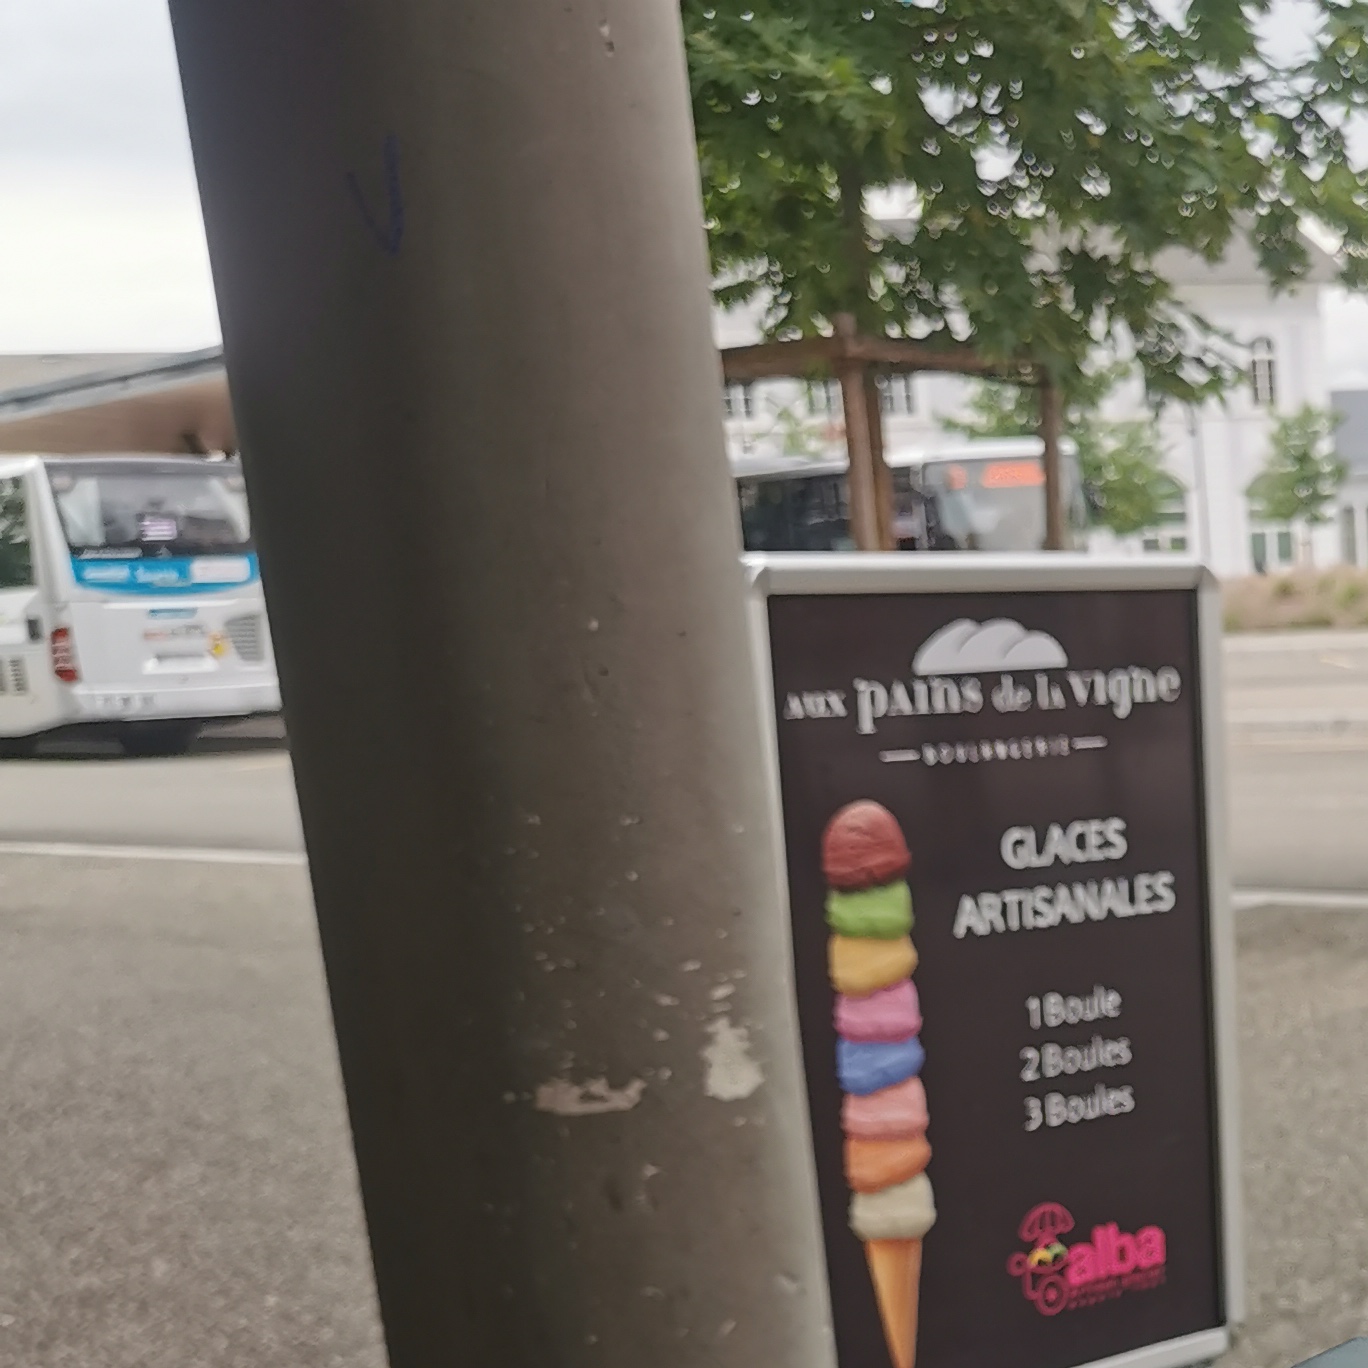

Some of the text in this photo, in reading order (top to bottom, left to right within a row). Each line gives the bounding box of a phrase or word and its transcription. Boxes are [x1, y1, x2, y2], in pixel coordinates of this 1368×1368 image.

[1000, 816, 1128, 870] GLACES
[952, 870, 1176, 939] ARTISANALES
[1025, 983, 1123, 1030] 1 Boule
[1019, 1034, 1133, 1082] 2 Boules
[1022, 1082, 1136, 1132] 3 Boules
